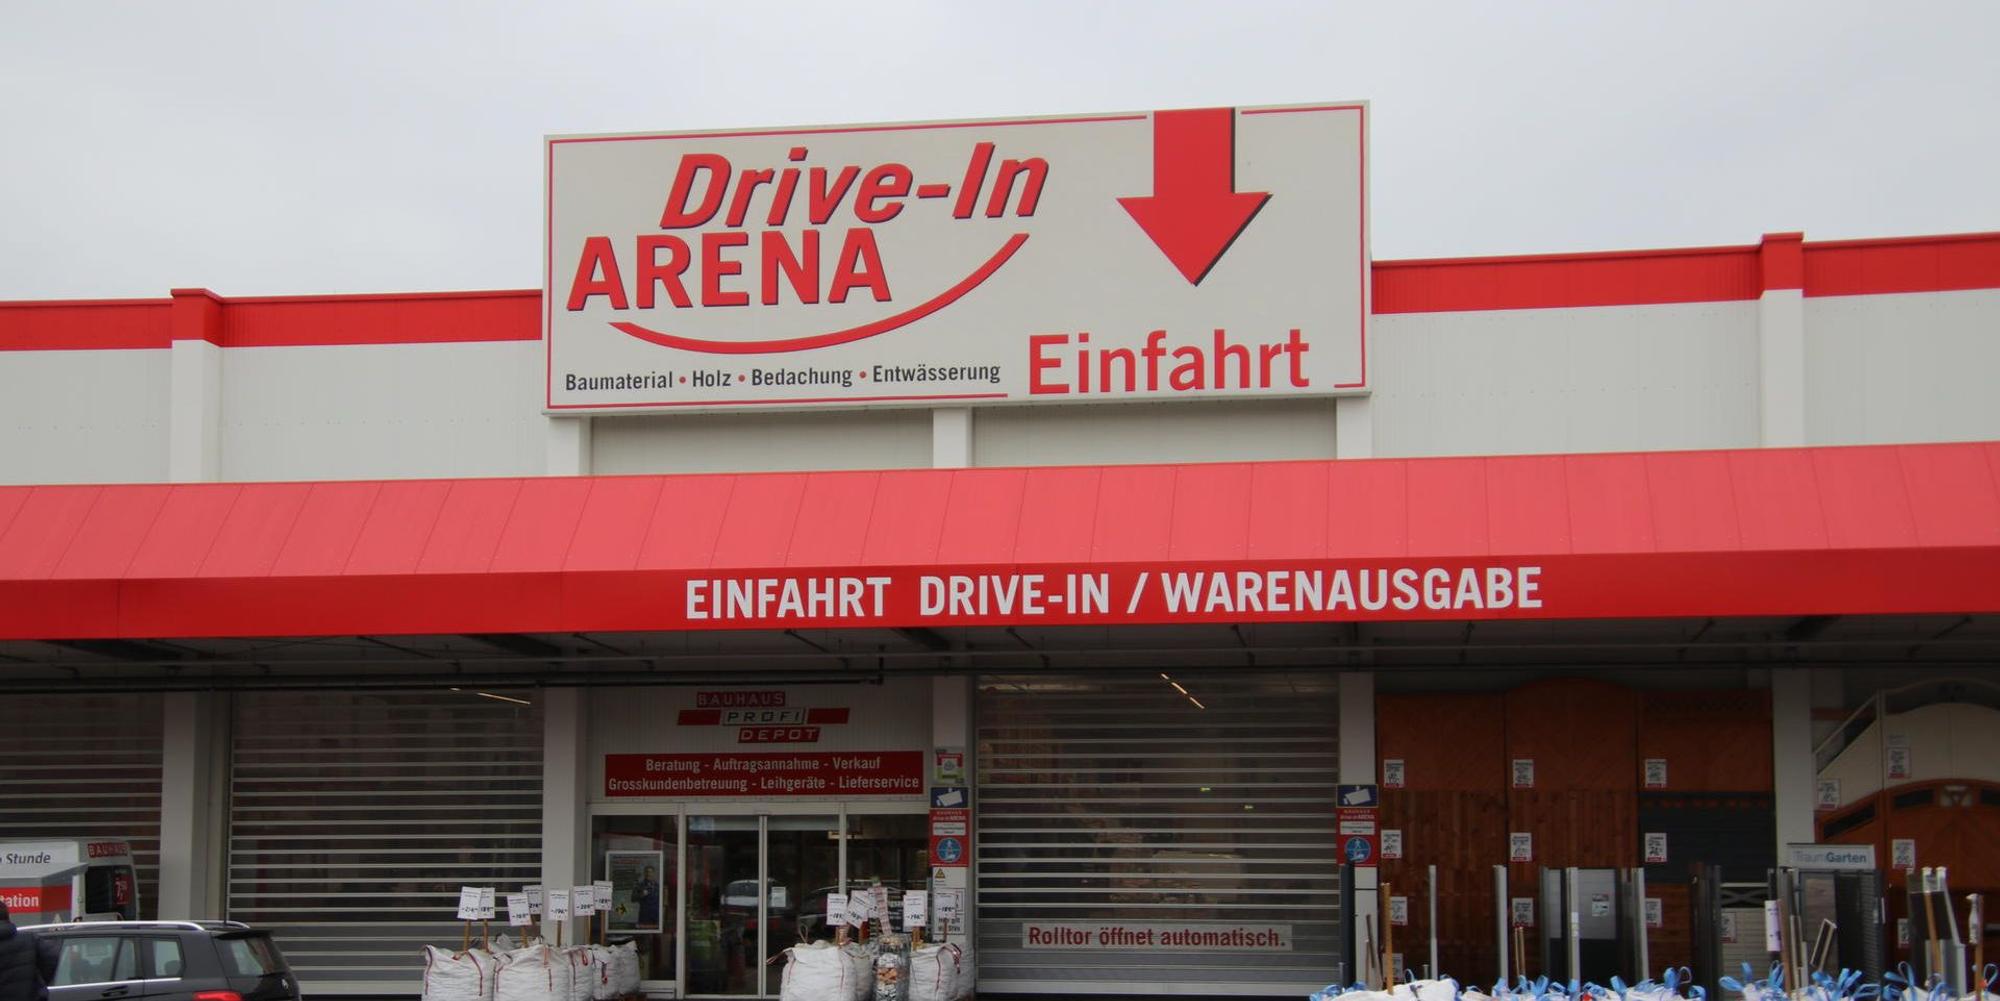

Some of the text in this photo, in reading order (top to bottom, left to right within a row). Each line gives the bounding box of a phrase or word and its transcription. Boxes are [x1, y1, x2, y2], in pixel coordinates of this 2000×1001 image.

[659, 142, 1049, 229] Drive-In
[566, 227, 892, 311] ARENA
[1029, 329, 1310, 394] Einfahrt
[566, 363, 1001, 391] Baumaterial Holz Bedachung Entwässerung
[686, 577, 891, 619] EINFAHRT
[920, 573, 1109, 616] DRIVE-IN
[1161, 566, 1542, 614] WARENAUSGABE
[698, 692, 784, 707] BAUHAUS
[727, 711, 800, 722] PROFI
[741, 729, 817, 740] DEPOT
[646, 758, 700, 774] Beratung
[713, 757, 820, 774] Auftragsannahme
[833, 756, 881, 770] Verkauf
[608, 777, 748, 792] Grosskundenbetreuung
[761, 776, 825, 792] Leihgeräte
[839, 775, 919, 789] Lieferservice
[6, 852, 51, 864] Stunde
[1028, 926, 1286, 947] Rolltor öffnet automatisch.
